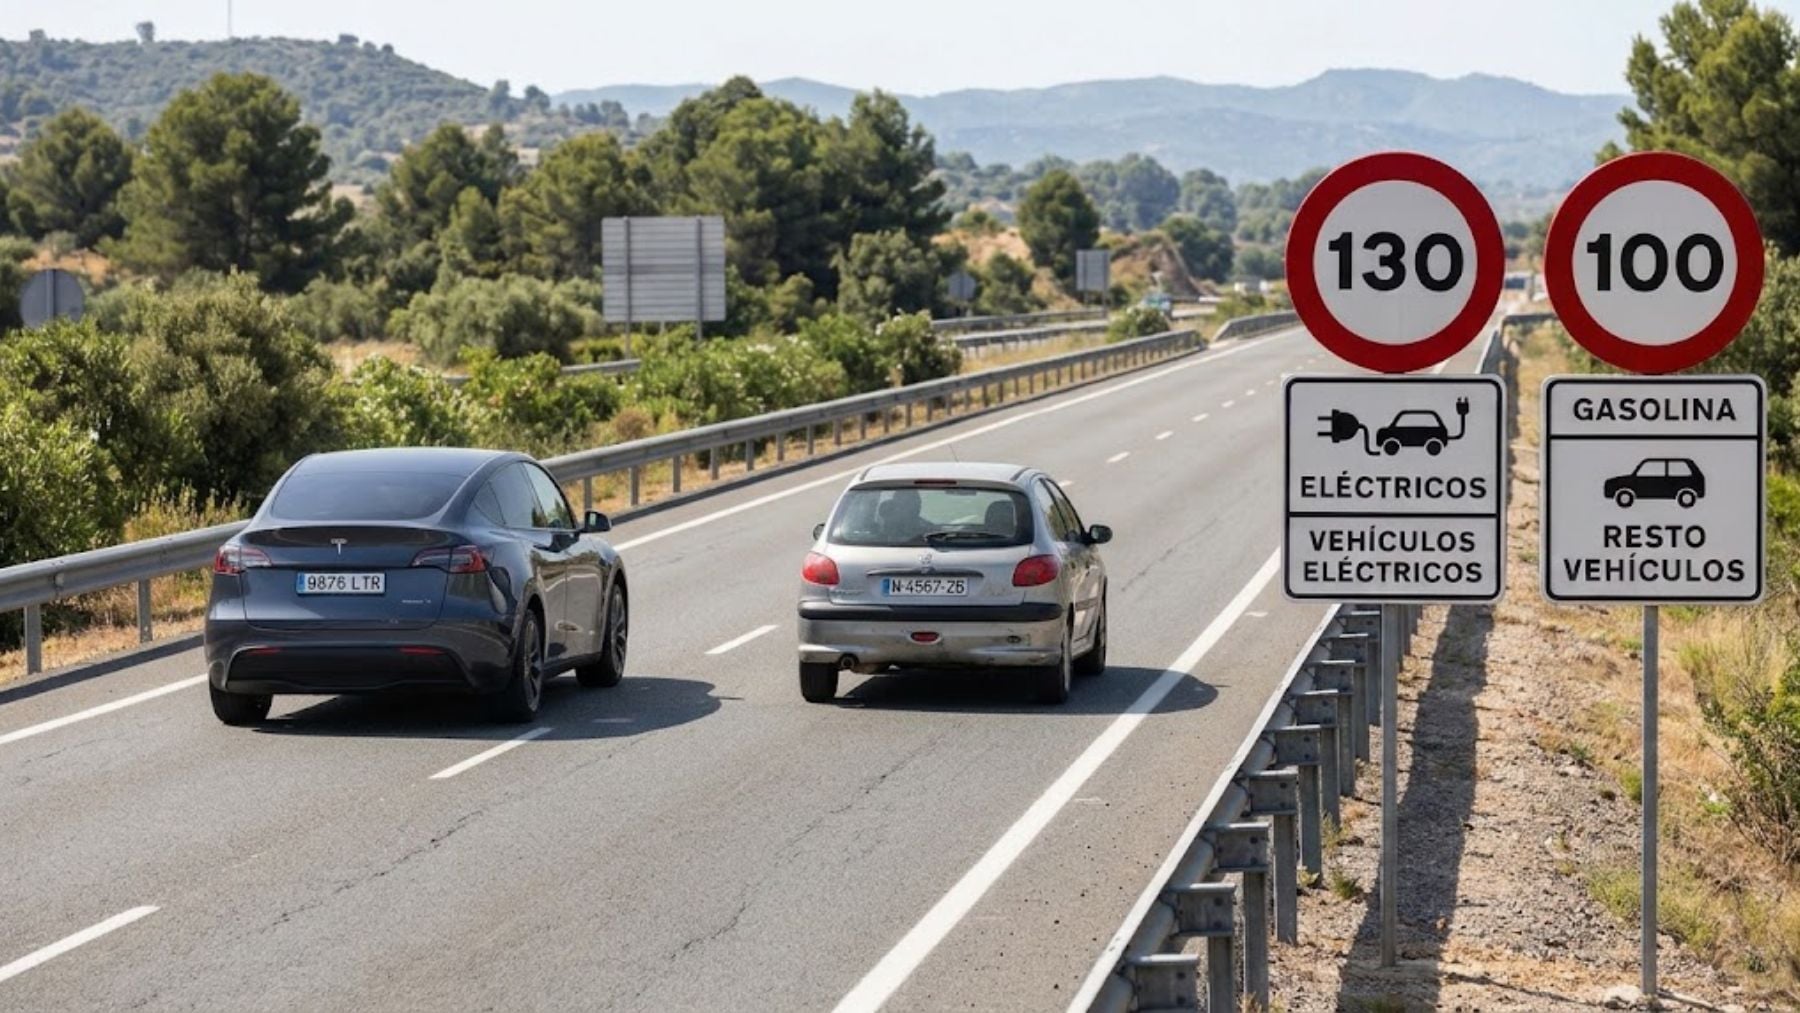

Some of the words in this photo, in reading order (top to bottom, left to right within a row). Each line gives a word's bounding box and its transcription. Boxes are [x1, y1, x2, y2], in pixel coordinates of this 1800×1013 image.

[1328, 232, 1464, 292] 130
[1587, 233, 1724, 292] 100
[1574, 398, 1736, 421] GASOLINA
[1301, 471, 1487, 499] ELÉCTRICOS
[1310, 526, 1475, 552] VEHÍCULOS
[1604, 525, 1706, 549] RESTO
[1303, 555, 1483, 584] ELÉCTRICOS
[1564, 553, 1745, 582] VEHÍCULOS
[307, 575, 346, 591] 9876
[352, 576, 380, 591] LTR
